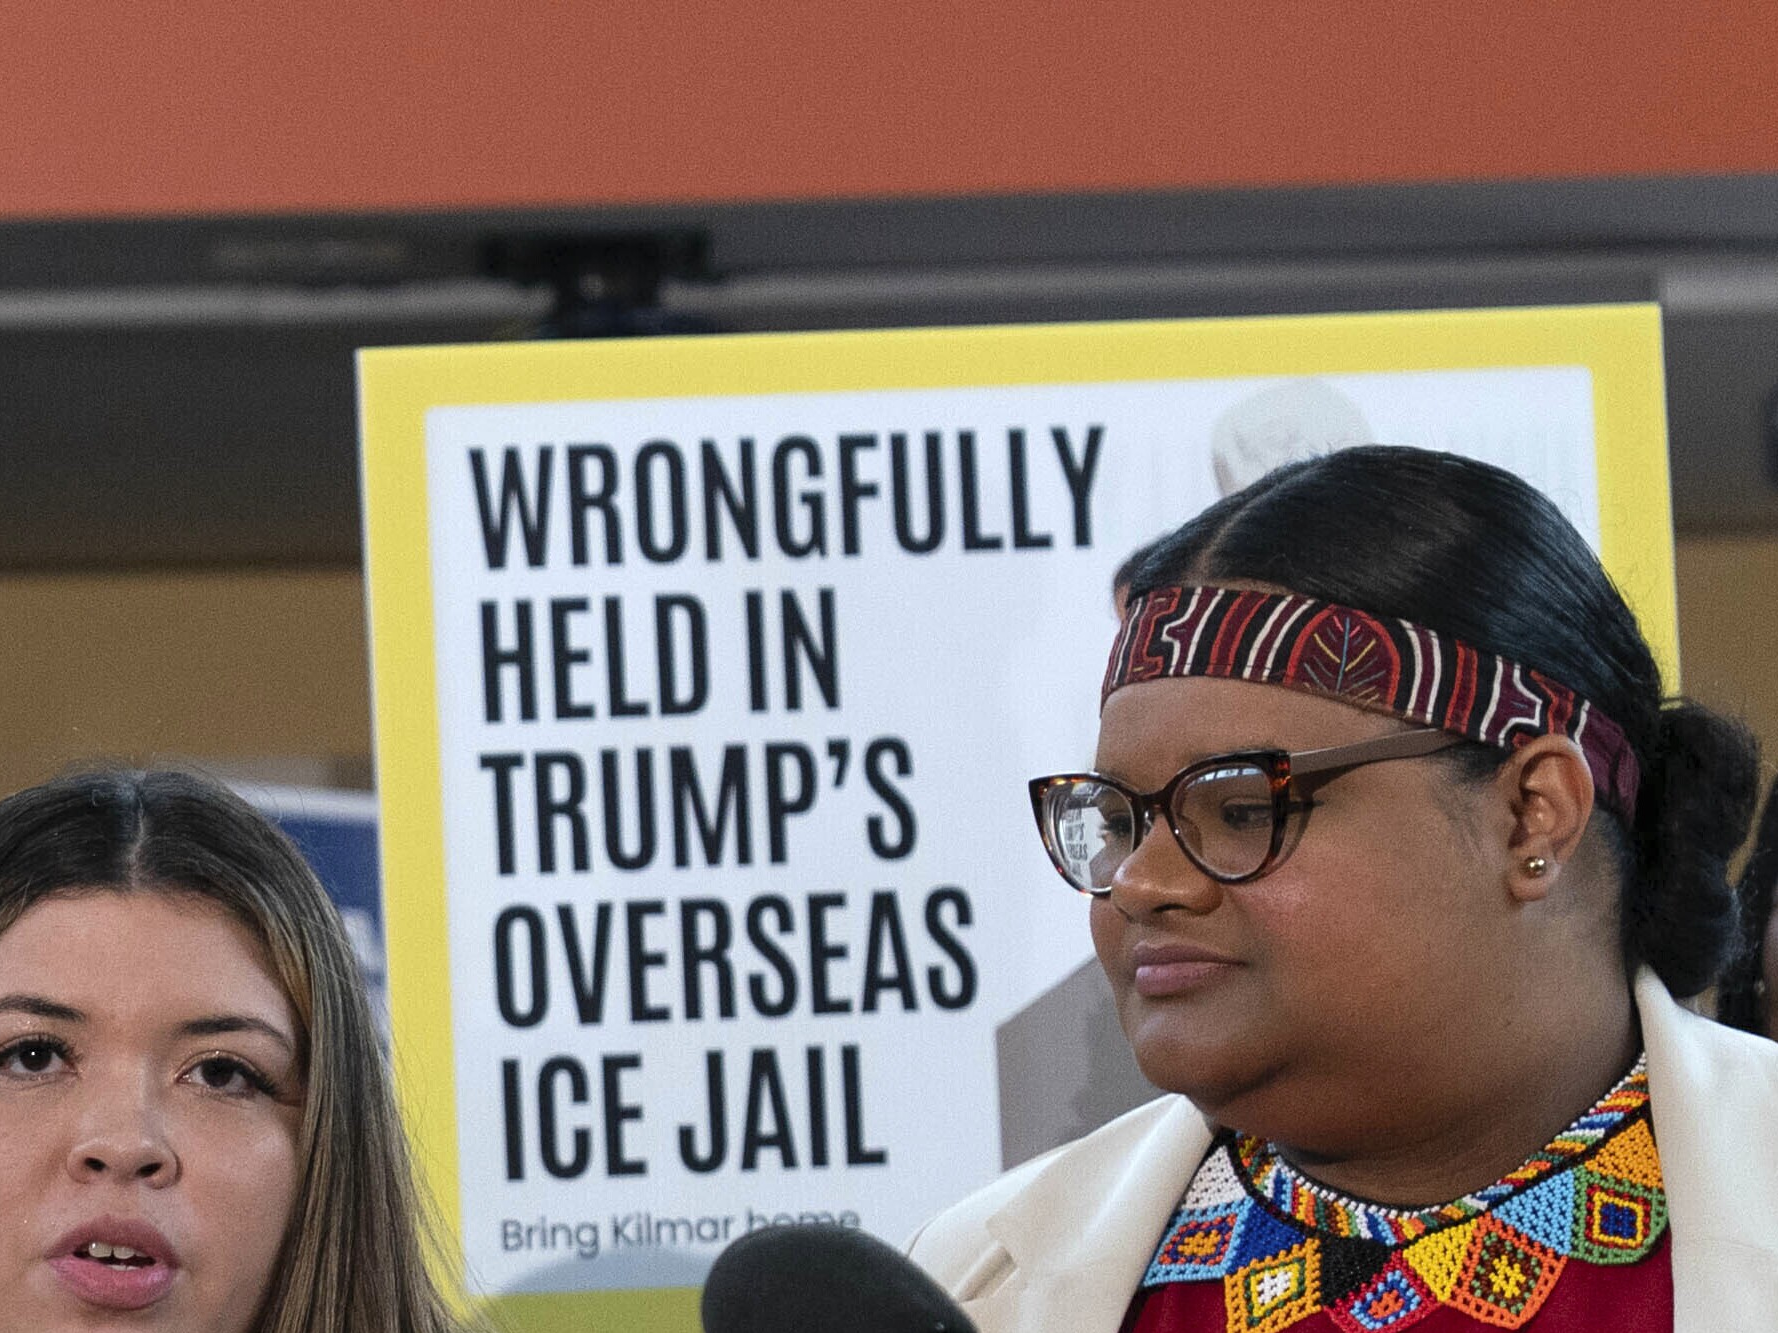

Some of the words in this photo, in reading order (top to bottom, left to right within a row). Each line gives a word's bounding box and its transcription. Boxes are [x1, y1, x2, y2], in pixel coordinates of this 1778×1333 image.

[469, 427, 1102, 569] WRONGFULLY
[481, 595, 709, 723] HELD
[746, 589, 839, 712] IN
[480, 738, 916, 875] TRUMP’S
[494, 887, 977, 1028] OVERSEAS
[502, 1054, 646, 1181] ICE
[679, 1045, 886, 1174] JAIL
[501, 1215, 600, 1259] Bring
[613, 1211, 734, 1249] Kilmar
